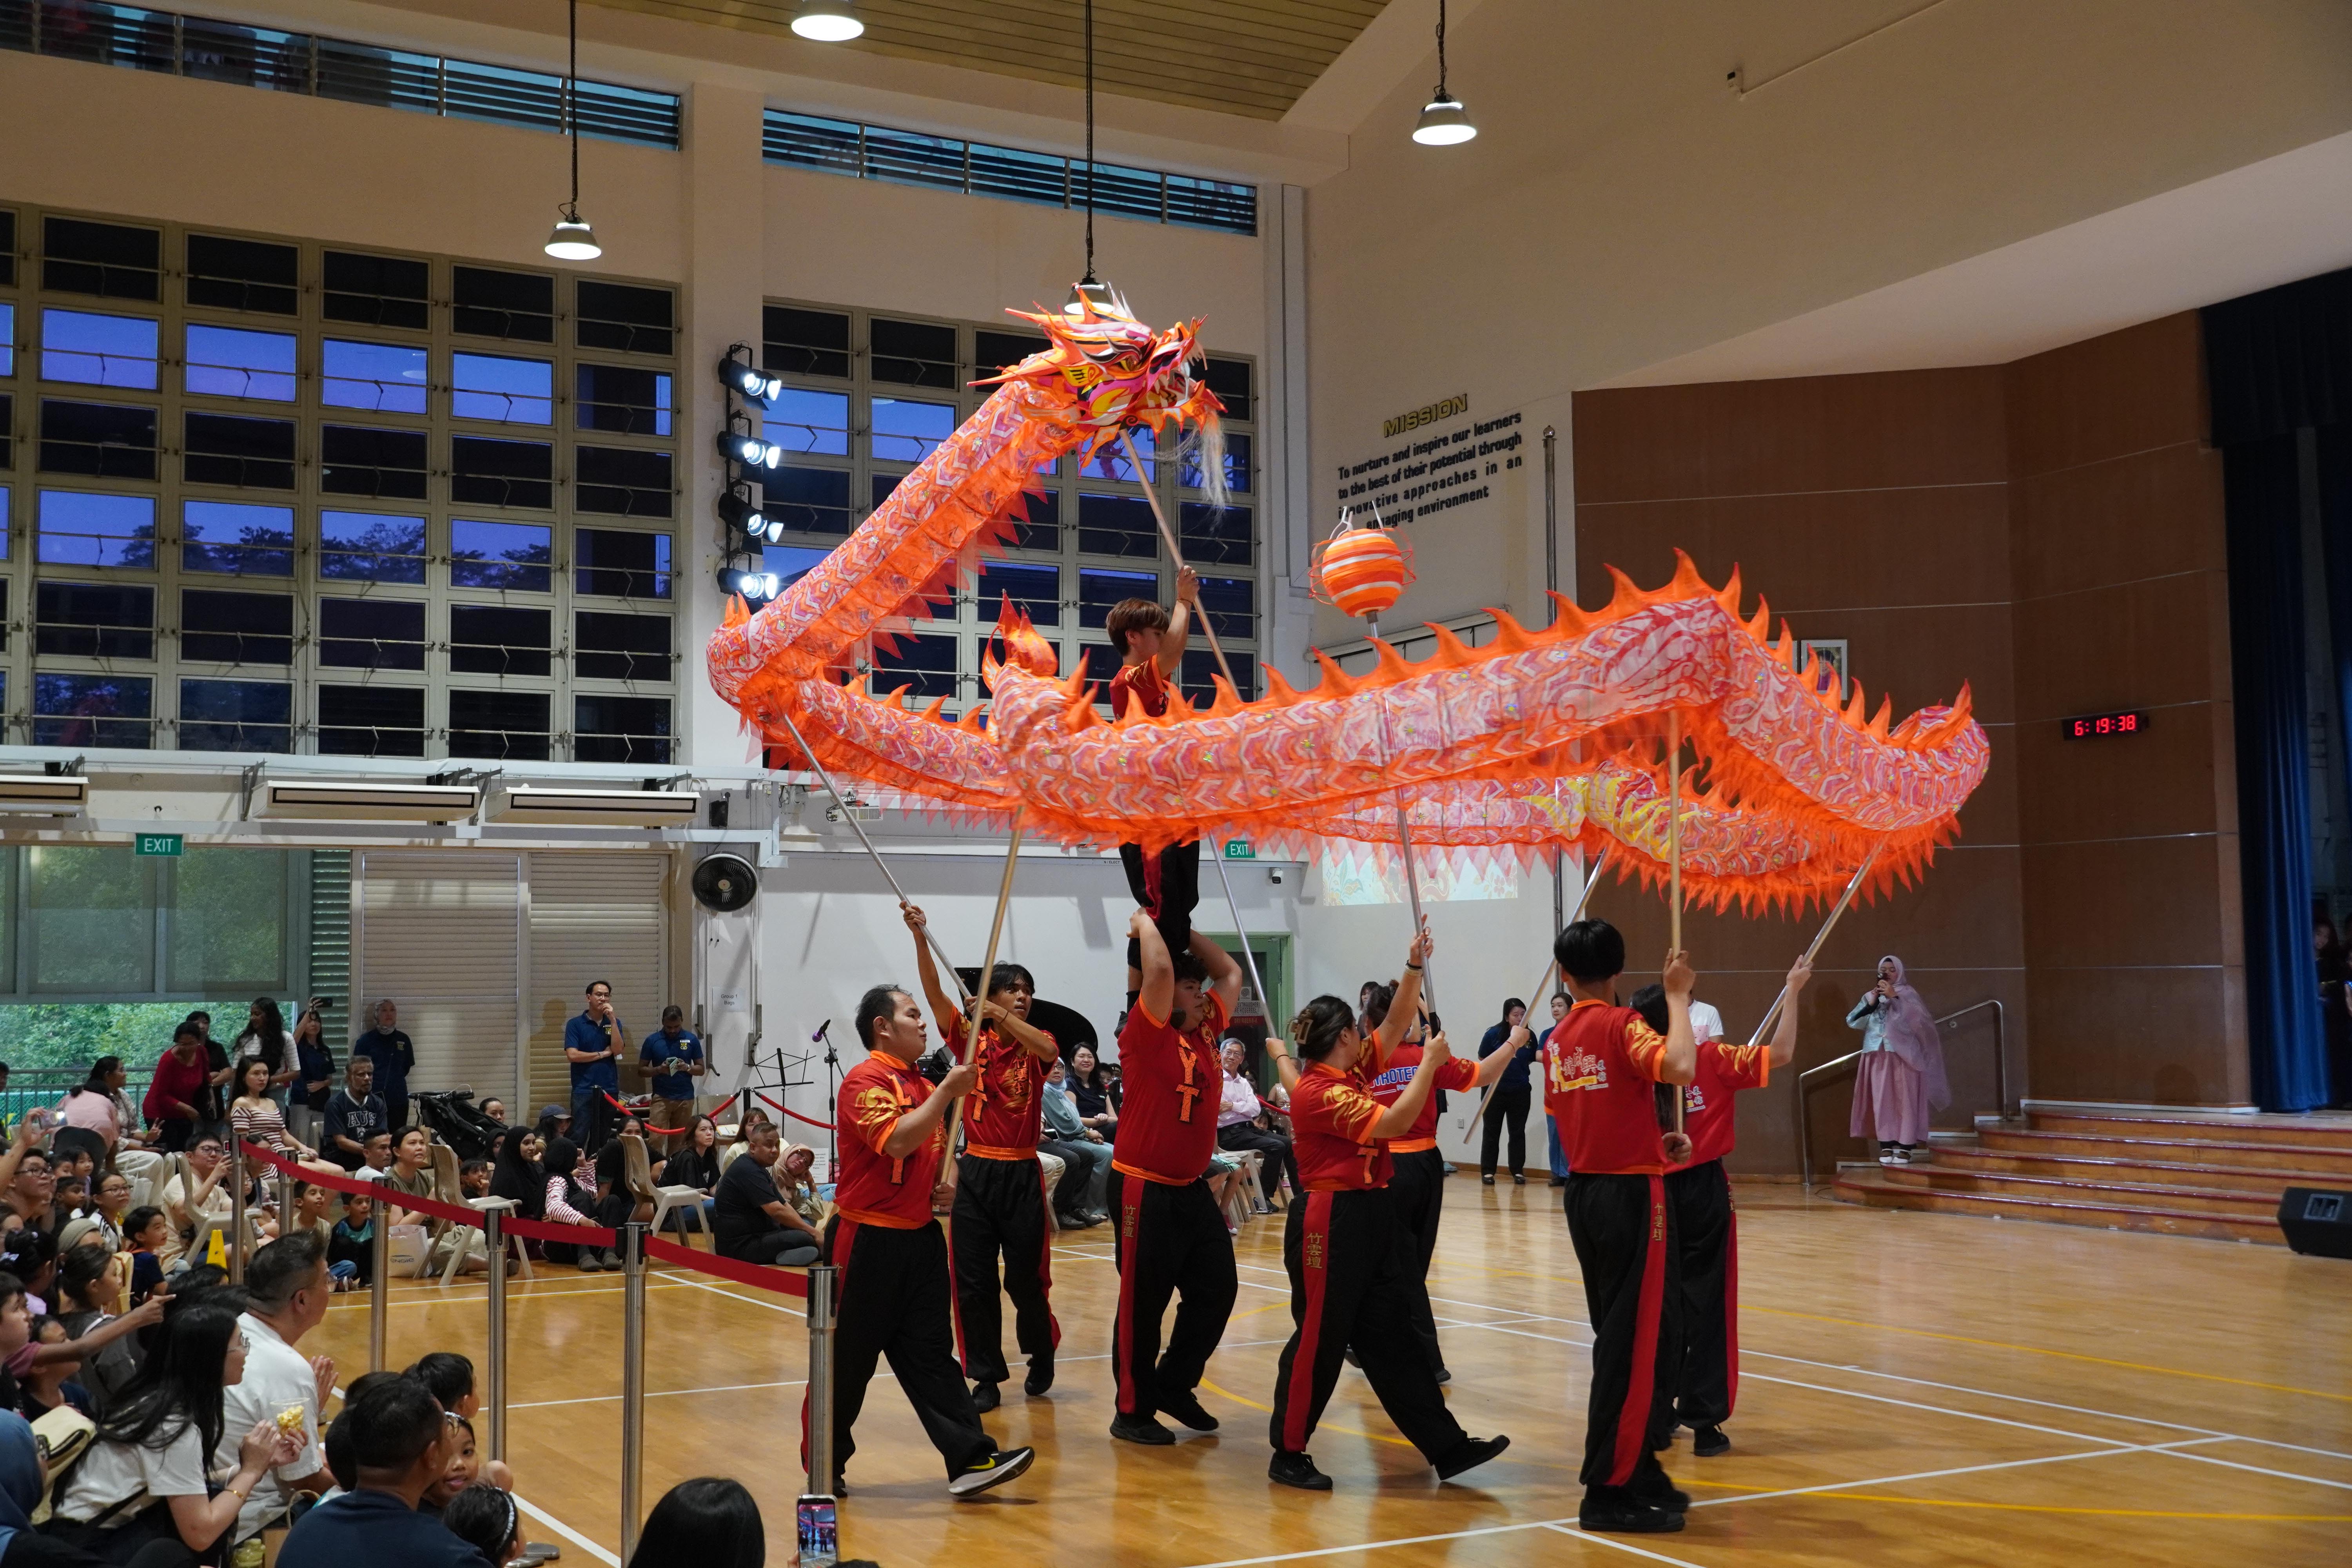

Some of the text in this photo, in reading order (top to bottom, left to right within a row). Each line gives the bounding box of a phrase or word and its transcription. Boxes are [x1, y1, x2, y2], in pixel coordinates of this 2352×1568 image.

[1384, 394, 1467, 438] MISSION
[1338, 413, 1521, 480] To nurture and inspire our learners
[1338, 431, 1522, 499] to the best of their potential through
[1403, 468, 1477, 501] approaches
[1486, 461, 1497, 475] in
[1506, 456, 1522, 469] an
[1417, 485, 1489, 517] environment
[2074, 715, 2136, 736] 6:19:38
[145, 838, 173, 852] EXIT
[1230, 844, 1249, 855] EXIT
[347, 1110, 377, 1127] AUS
[1123, 1204, 1136, 1238] 竹雲壇
[1306, 1232, 1323, 1269] 竹雲壇
